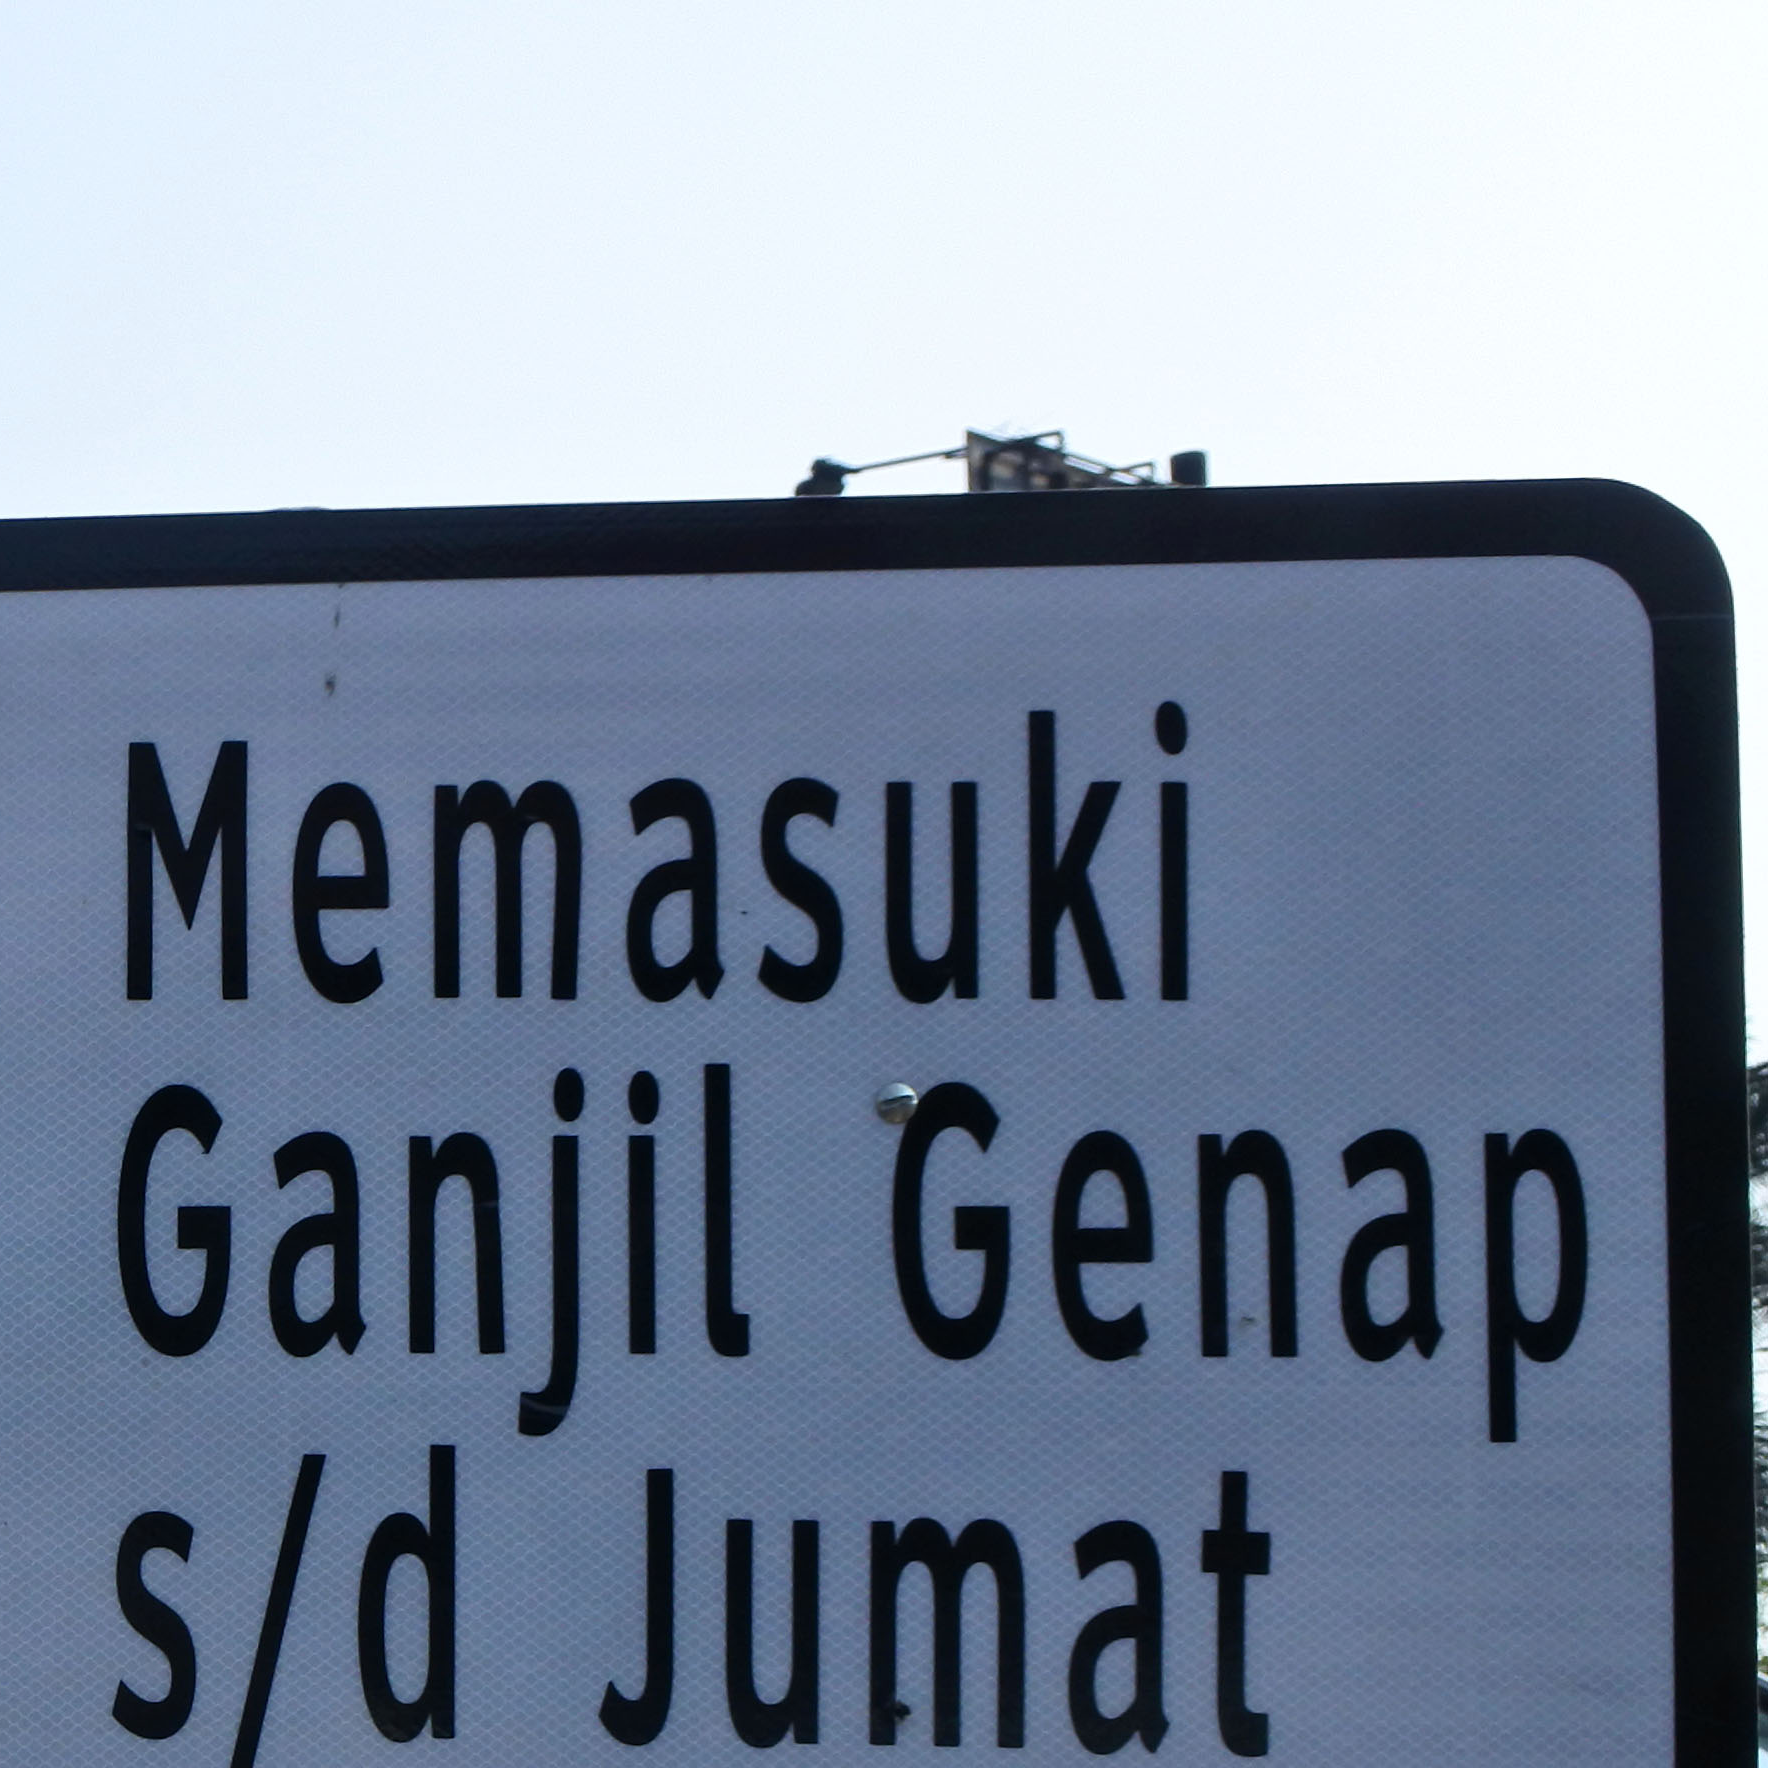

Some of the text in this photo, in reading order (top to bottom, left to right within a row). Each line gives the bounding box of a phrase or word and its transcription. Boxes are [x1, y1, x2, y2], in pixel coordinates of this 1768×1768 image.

[124, 700, 1192, 1008] Memasuki
[113, 1062, 753, 1440] Ganjil
[887, 1077, 1593, 1449] Genap
[595, 1464, 1273, 1760] Jumat
